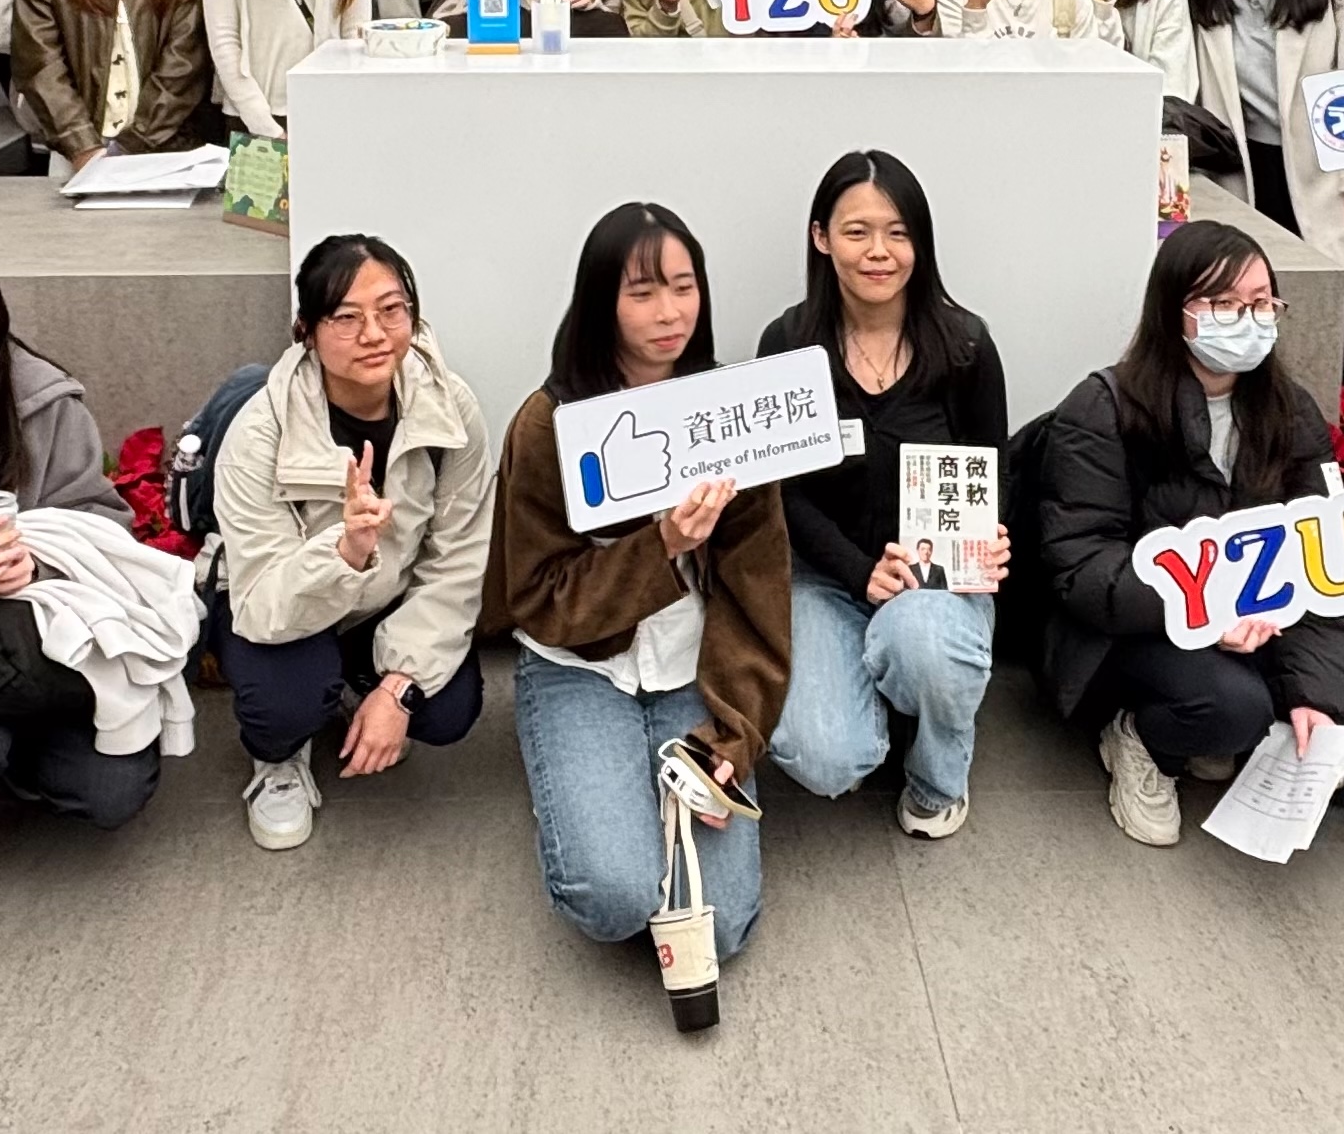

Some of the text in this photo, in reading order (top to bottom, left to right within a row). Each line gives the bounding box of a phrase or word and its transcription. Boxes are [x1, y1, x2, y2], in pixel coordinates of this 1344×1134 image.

[682, 387, 818, 451] 資訊學院
[680, 456, 732, 480] College
[734, 449, 750, 465] of
[752, 430, 832, 461] Informatics
[965, 455, 988, 507] 微軟
[937, 454, 961, 532] 商學院
